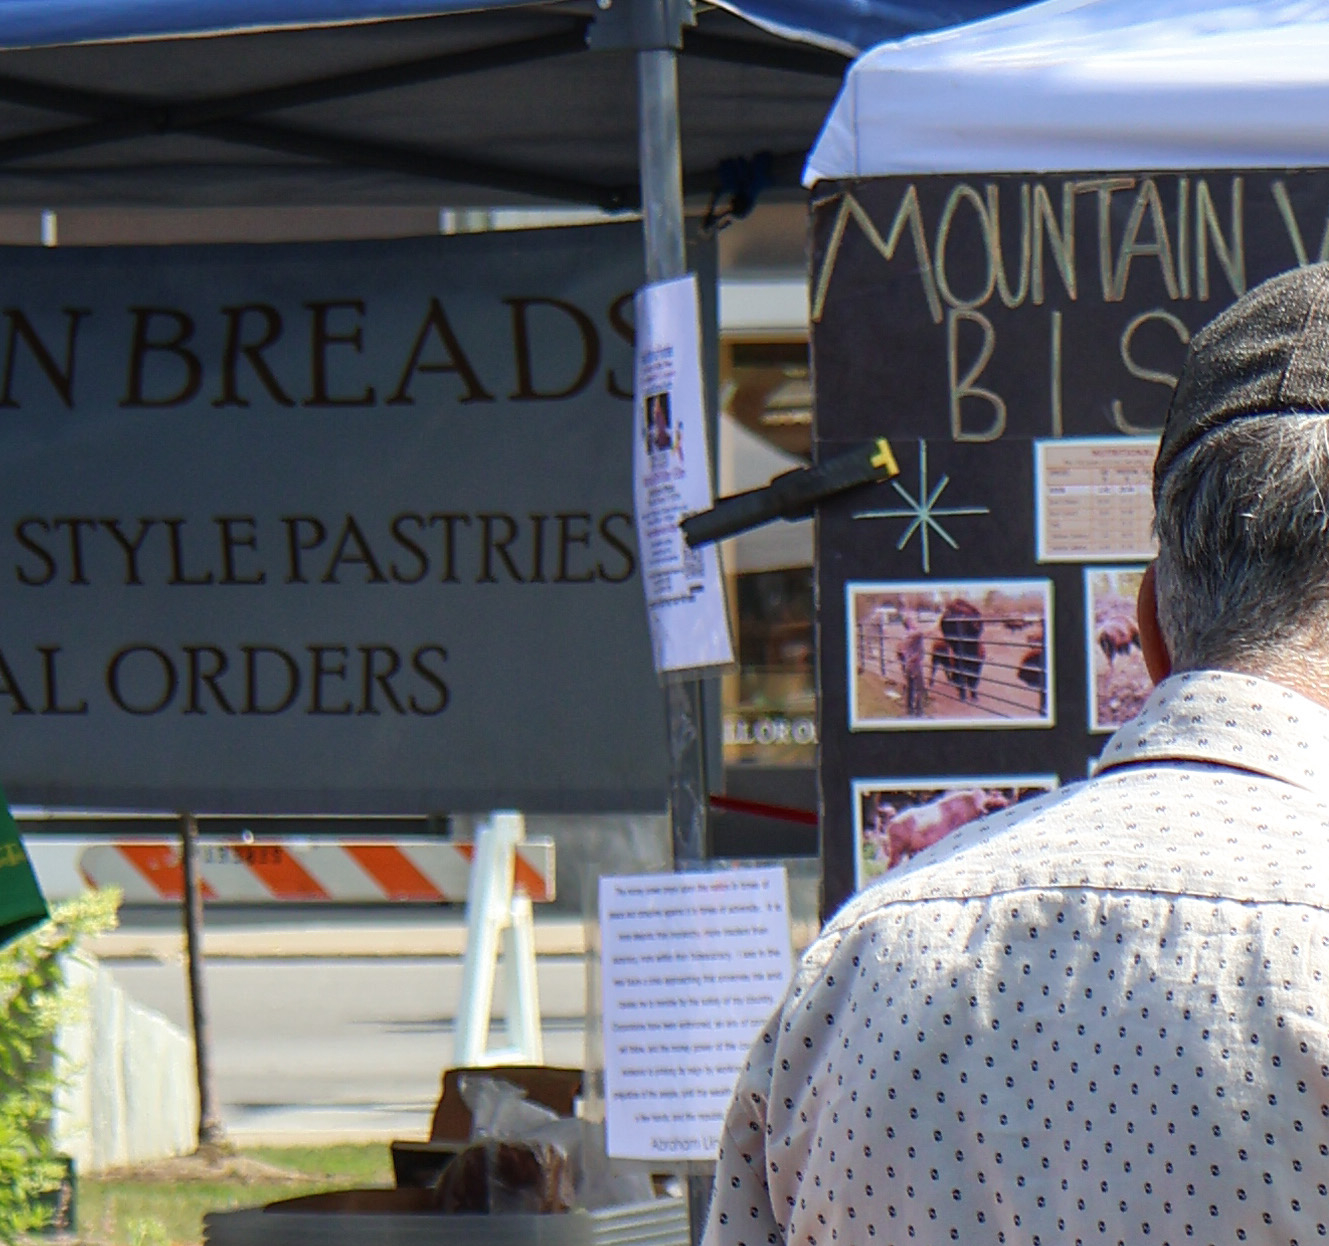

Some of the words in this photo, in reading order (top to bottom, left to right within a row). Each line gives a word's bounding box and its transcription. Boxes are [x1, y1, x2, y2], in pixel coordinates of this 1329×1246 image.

[811, 176, 1249, 324] MOUNTAIN
[0, 305, 93, 410] N
[117, 293, 636, 411] BREADS
[13, 514, 266, 586] STYLE
[280, 511, 637, 585] PASTRIES
[106, 642, 451, 717] ORDERS
